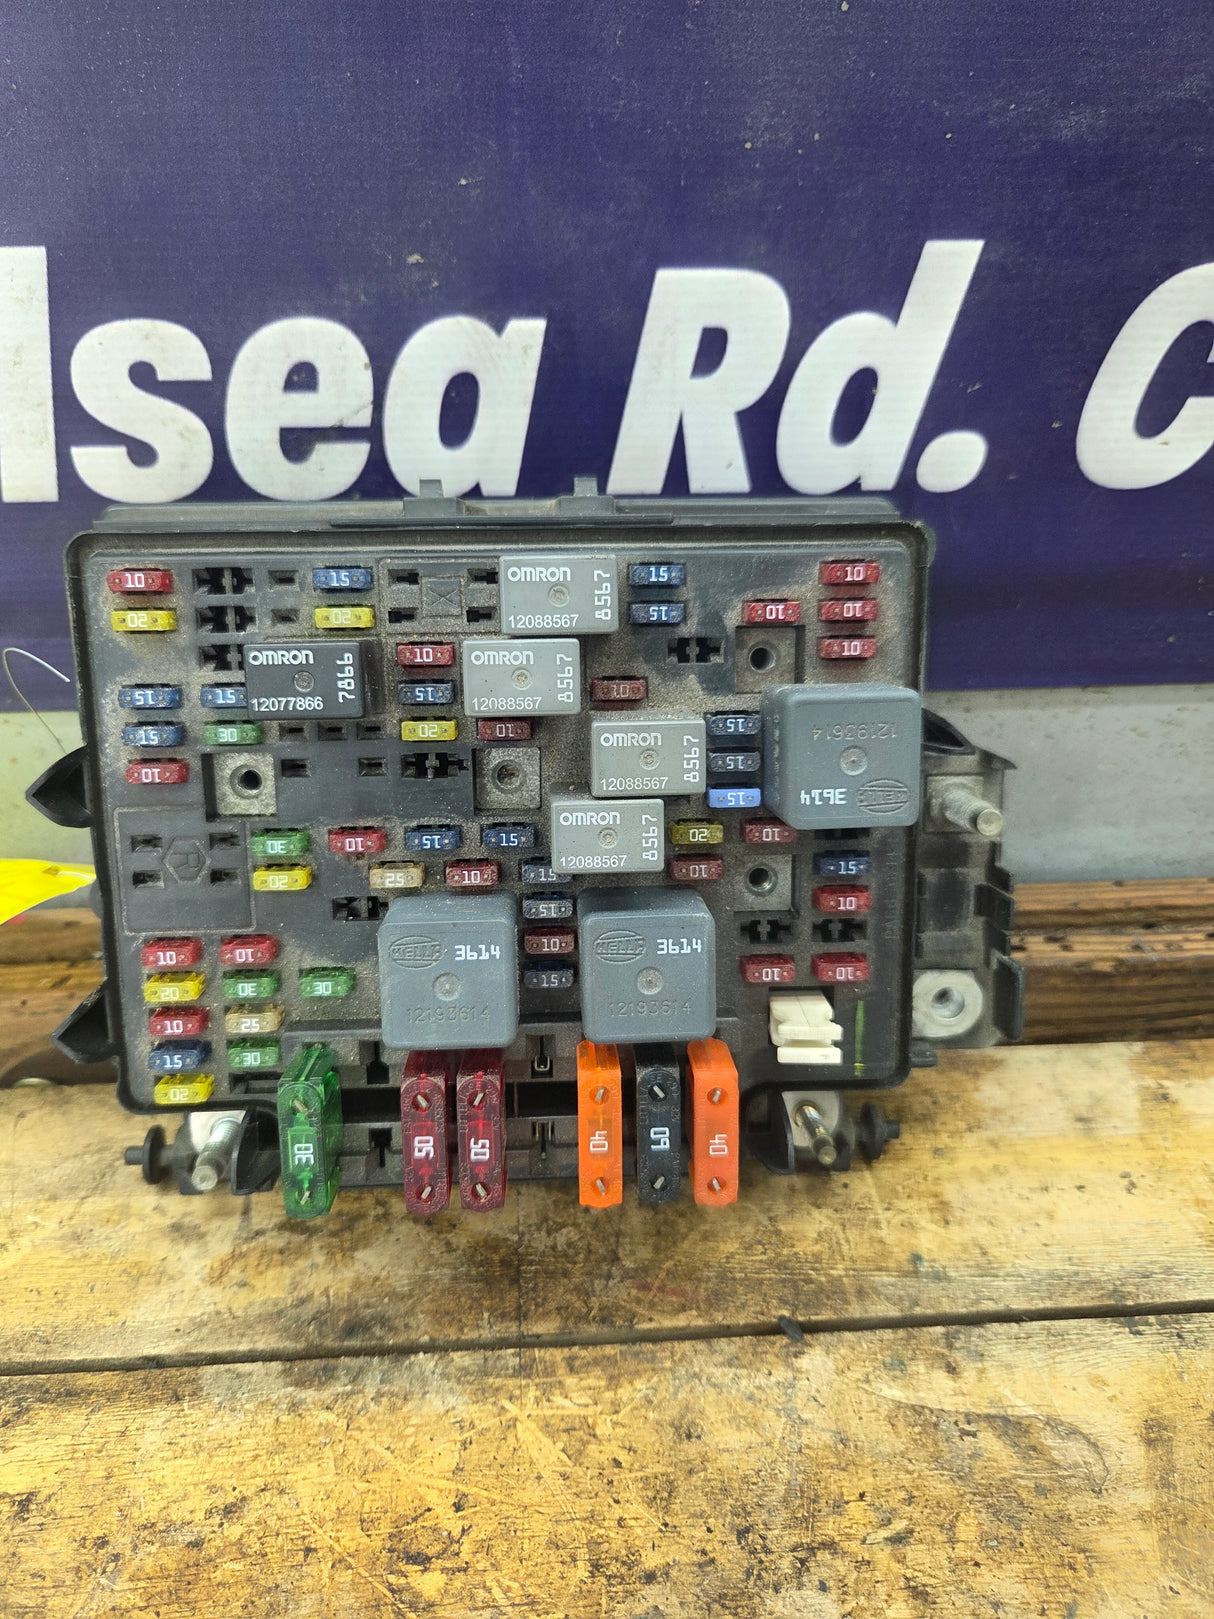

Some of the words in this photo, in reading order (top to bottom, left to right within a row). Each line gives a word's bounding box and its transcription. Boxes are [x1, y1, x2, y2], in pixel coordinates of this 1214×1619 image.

[607, 239, 989, 494] Rd.
[330, 572, 350, 586] 15
[507, 566, 571, 582] OMRON
[650, 568, 668, 581] 15
[845, 567, 864, 581] 10
[125, 574, 144, 588] 10
[594, 570, 611, 620] 8567
[650, 606, 667, 620] 15
[766, 604, 785, 619] 10
[844, 604, 862, 617] 10
[127, 614, 147, 627] 20
[330, 611, 351, 624] 20
[508, 615, 579, 628] 12088567
[414, 648, 433, 662] 10
[842, 642, 860, 655] 10
[249, 650, 313, 665] OMRON
[471, 651, 534, 665] OMRON
[336, 653, 354, 702] 7866
[557, 654, 573, 702] 8567
[215, 690, 236, 704] 15
[415, 688, 434, 701] 15
[611, 684, 629, 697] 10
[135, 691, 154, 705] 15
[252, 697, 323, 712] 12077866
[473, 697, 542, 711] 12088567
[419, 724, 437, 737] 20
[496, 724, 514, 736] 10
[727, 719, 745, 732] 15
[139, 730, 158, 744] 15
[218, 729, 237, 742] 30
[600, 733, 662, 746] OMRON
[684, 736, 700, 782] 8567
[726, 756, 744, 769] 15
[141, 769, 161, 782] 10
[601, 777, 668, 790] 12088567
[727, 792, 745, 805] 15
[801, 789, 846, 804] 3614
[559, 812, 620, 825] OMRON
[500, 833, 518, 846] 15
[642, 815, 658, 860] 8567
[690, 829, 707, 841] 20
[763, 828, 780, 840] 10
[266, 841, 286, 854] 30
[345, 838, 364, 851] 10
[422, 835, 441, 849] 15
[560, 855, 627, 868] 12088567
[838, 862, 856, 874] 15
[462, 871, 480, 883] 10
[539, 869, 556, 880] 15
[690, 865, 707, 877] 10
[269, 875, 288, 888] 20
[385, 872, 404, 885] 25
[540, 905, 556, 916] 15
[838, 898, 855, 910] 10
[541, 939, 559, 951] 10
[657, 938, 702, 954] 3614
[157, 952, 176, 964] 10
[236, 949, 255, 962] 10
[455, 945, 500, 960] 3614
[762, 968, 780, 981] 10
[836, 967, 854, 979] 10
[541, 975, 558, 986] 15
[160, 987, 179, 1000] 20
[238, 983, 257, 996] 30
[314, 982, 332, 994] 30
[164, 1020, 183, 1033] 10
[241, 1019, 259, 1031] 25
[164, 1055, 182, 1067] 15
[242, 1053, 260, 1065] 30
[170, 1089, 189, 1101] 20
[590, 1130, 609, 1152] 40
[651, 1127, 670, 1150] 60
[710, 1134, 727, 1155] 40
[295, 1143, 314, 1165] 30
[414, 1136, 435, 1159] 50
[470, 1137, 490, 1162] 50
